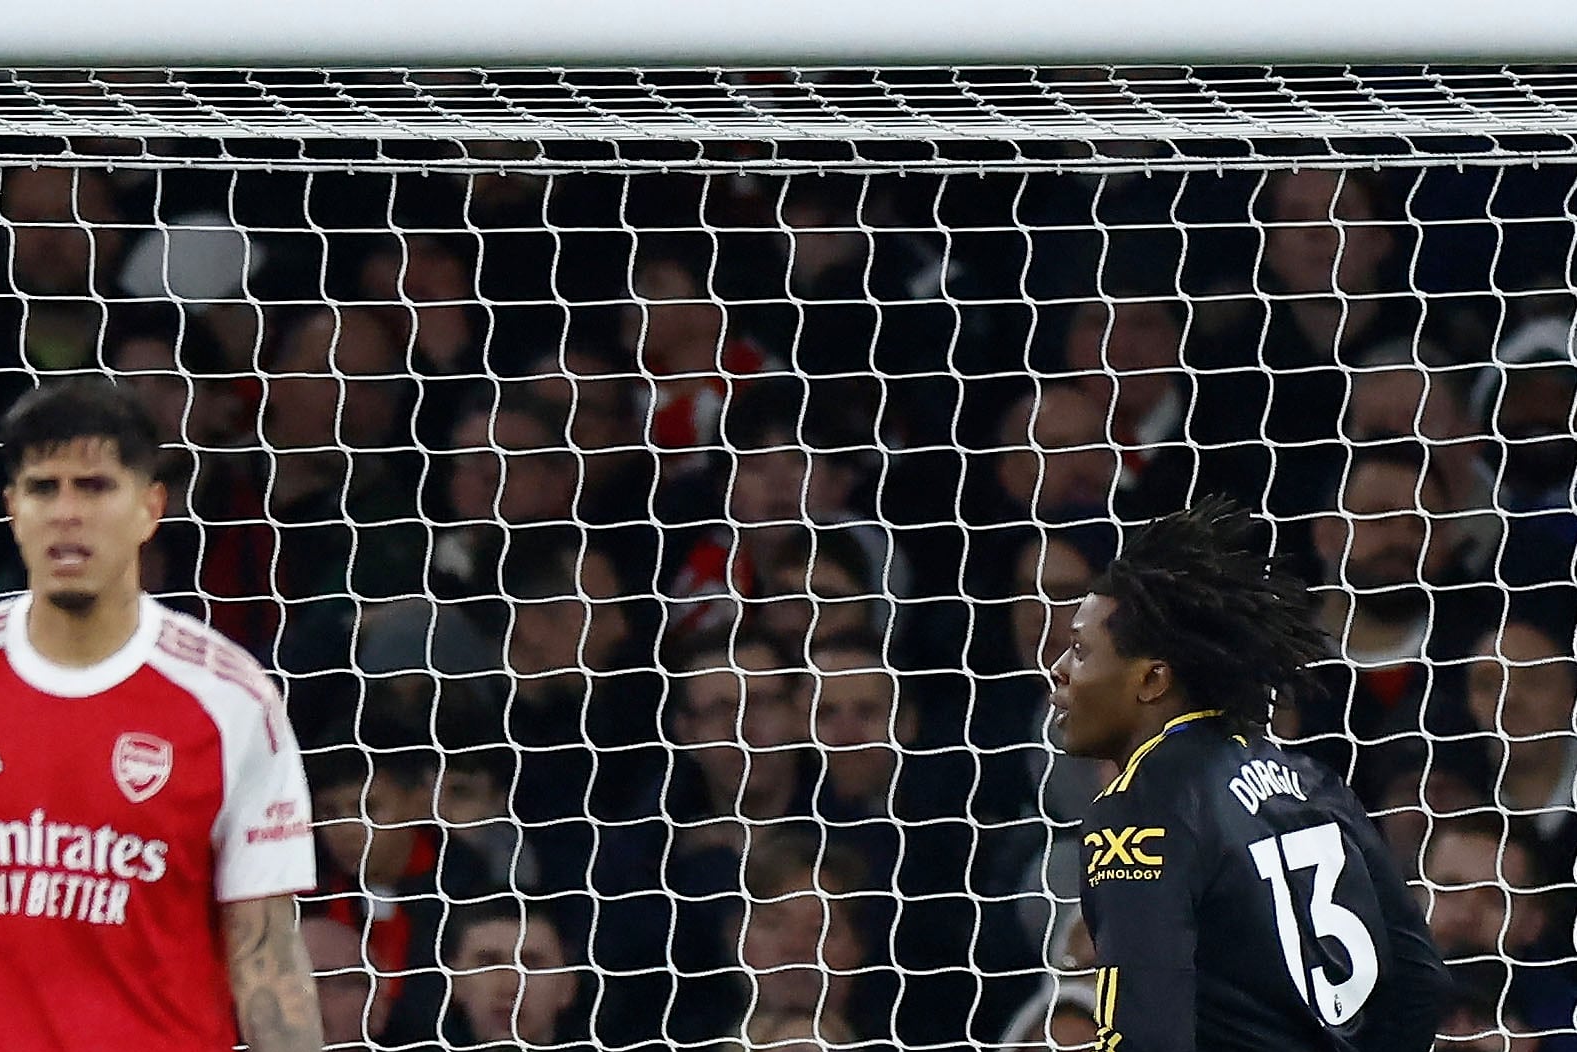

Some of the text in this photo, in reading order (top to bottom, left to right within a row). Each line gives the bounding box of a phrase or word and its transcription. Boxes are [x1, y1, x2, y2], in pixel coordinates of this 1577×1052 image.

[1228, 759, 1308, 815] DORGU
[24, 869, 131, 926] BETTER
[1088, 868, 1162, 888] THNOLOGY
[1247, 822, 1379, 1028] 13
